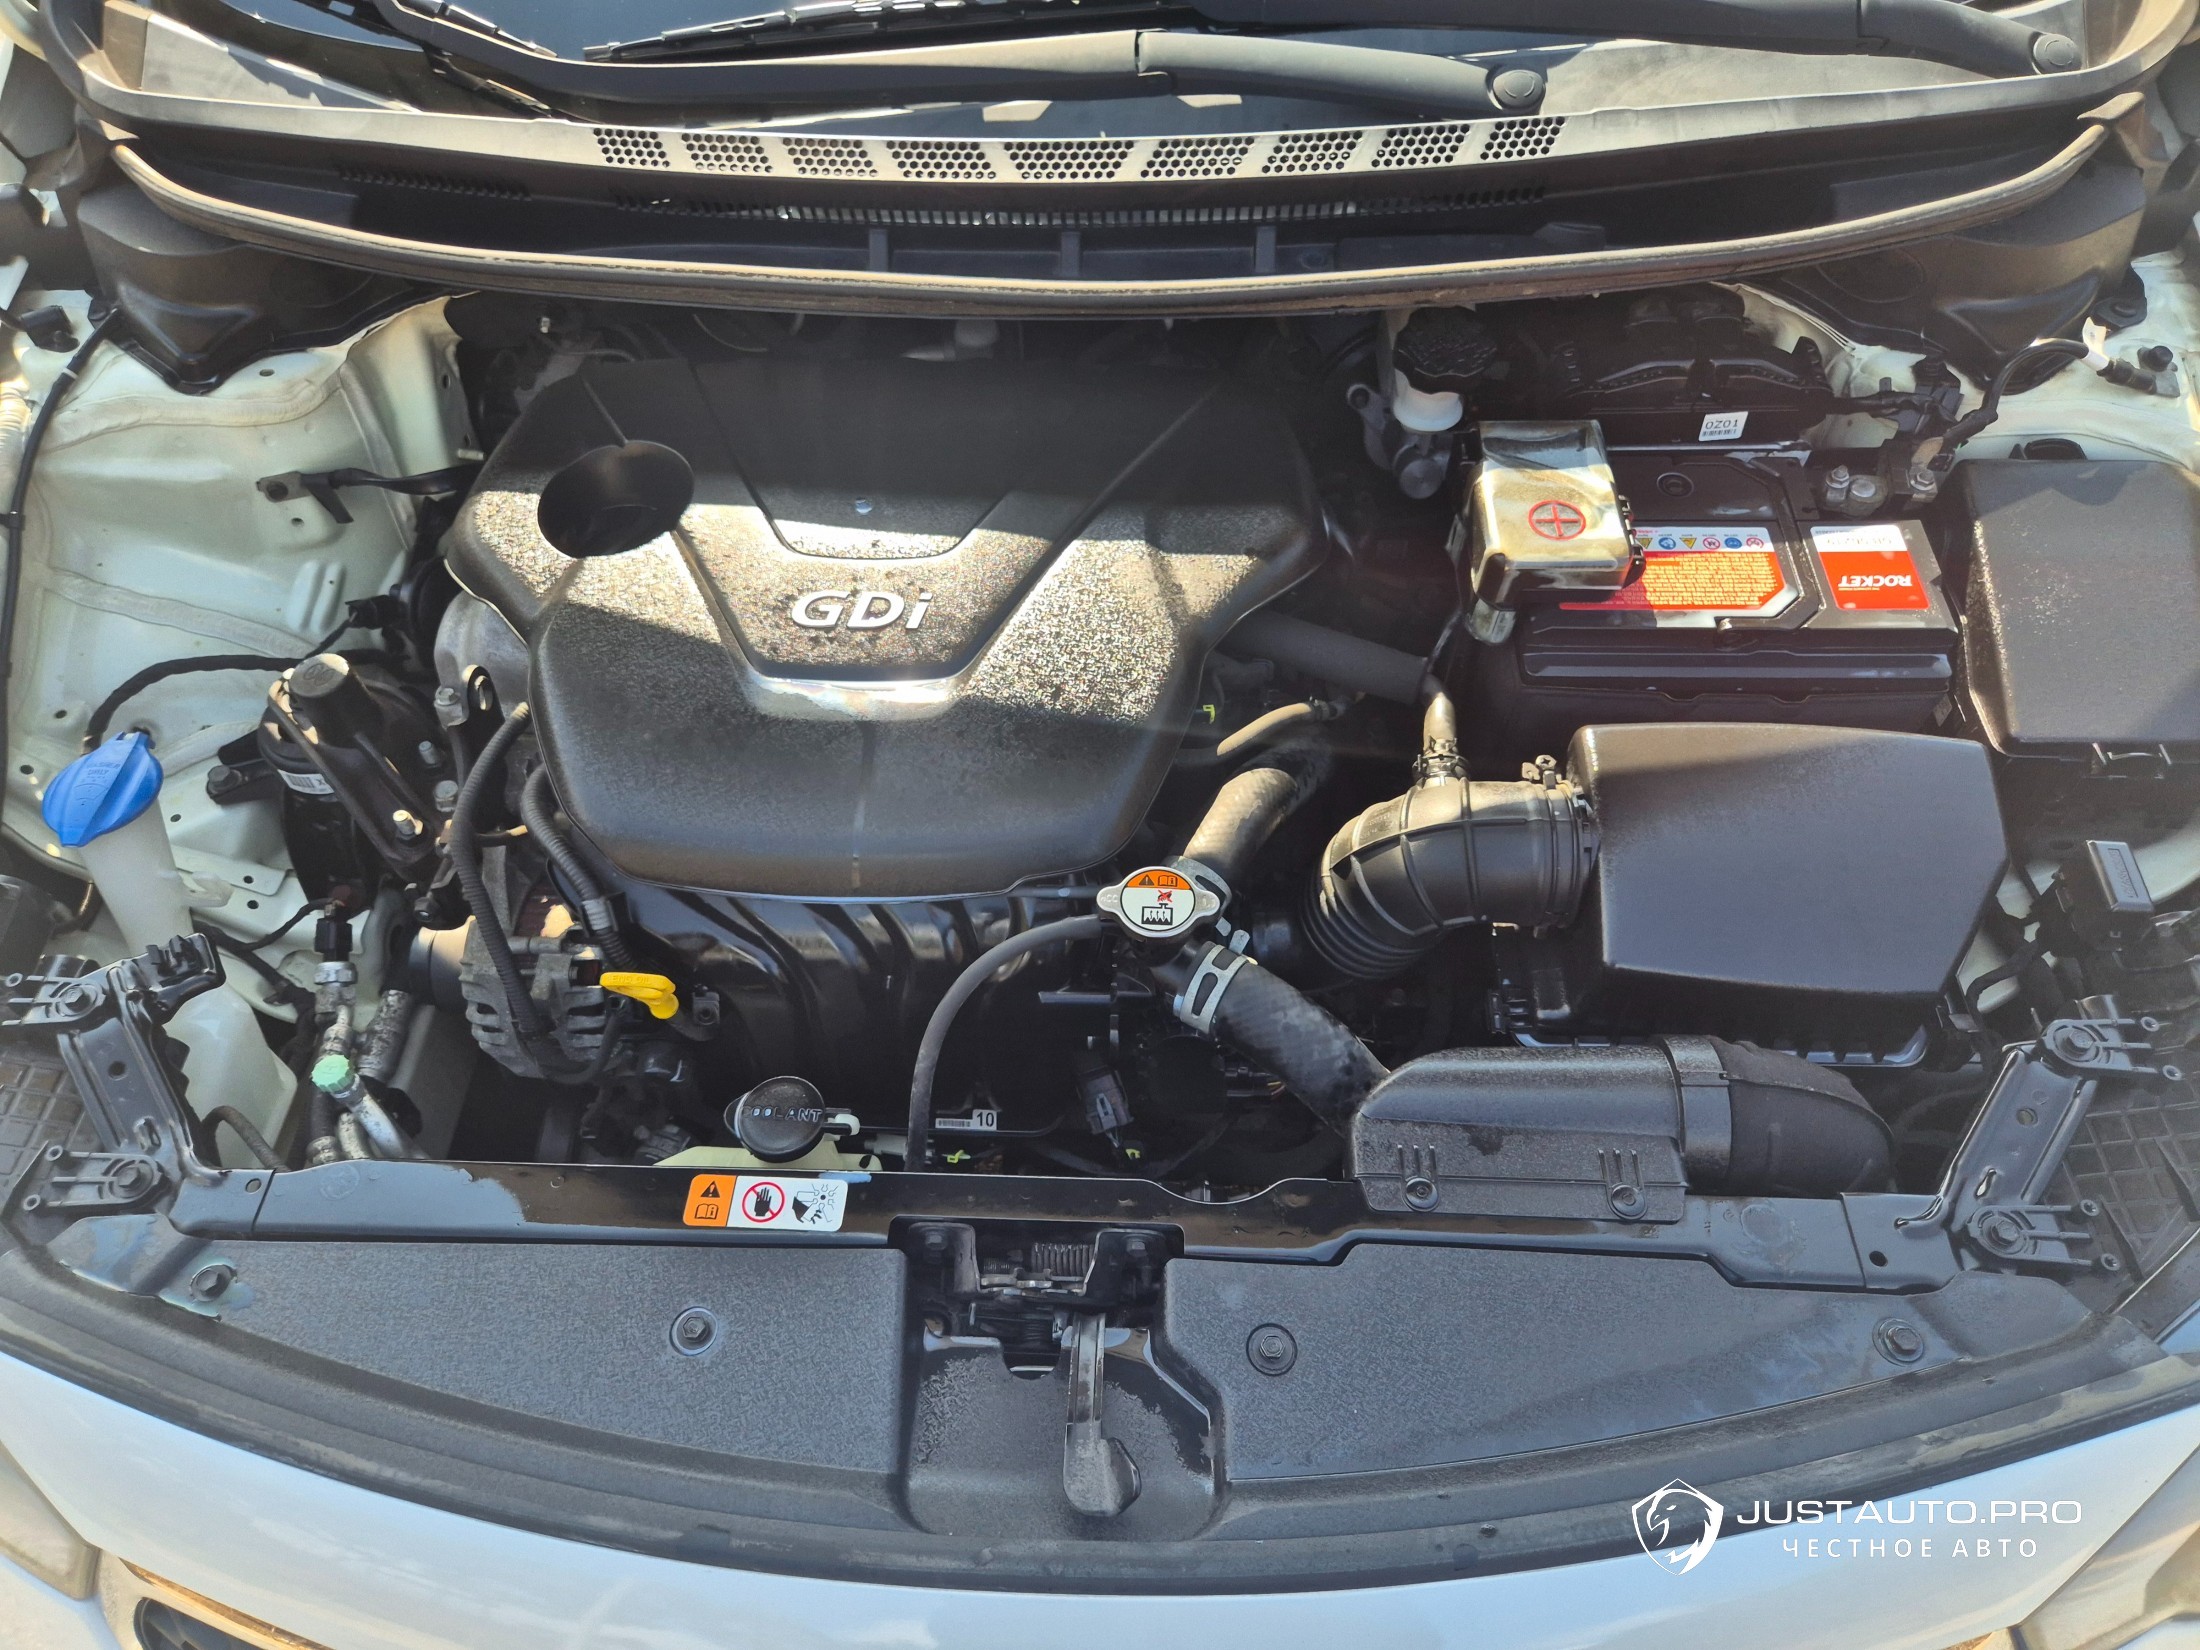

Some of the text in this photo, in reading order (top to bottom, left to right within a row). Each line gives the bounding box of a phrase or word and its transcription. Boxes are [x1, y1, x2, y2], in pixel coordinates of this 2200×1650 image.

[1838, 575, 1912, 587] ROCKET
[791, 590, 933, 630] GDi
[741, 1105, 823, 1123] COOLANT
[976, 1112, 995, 1127] 10
